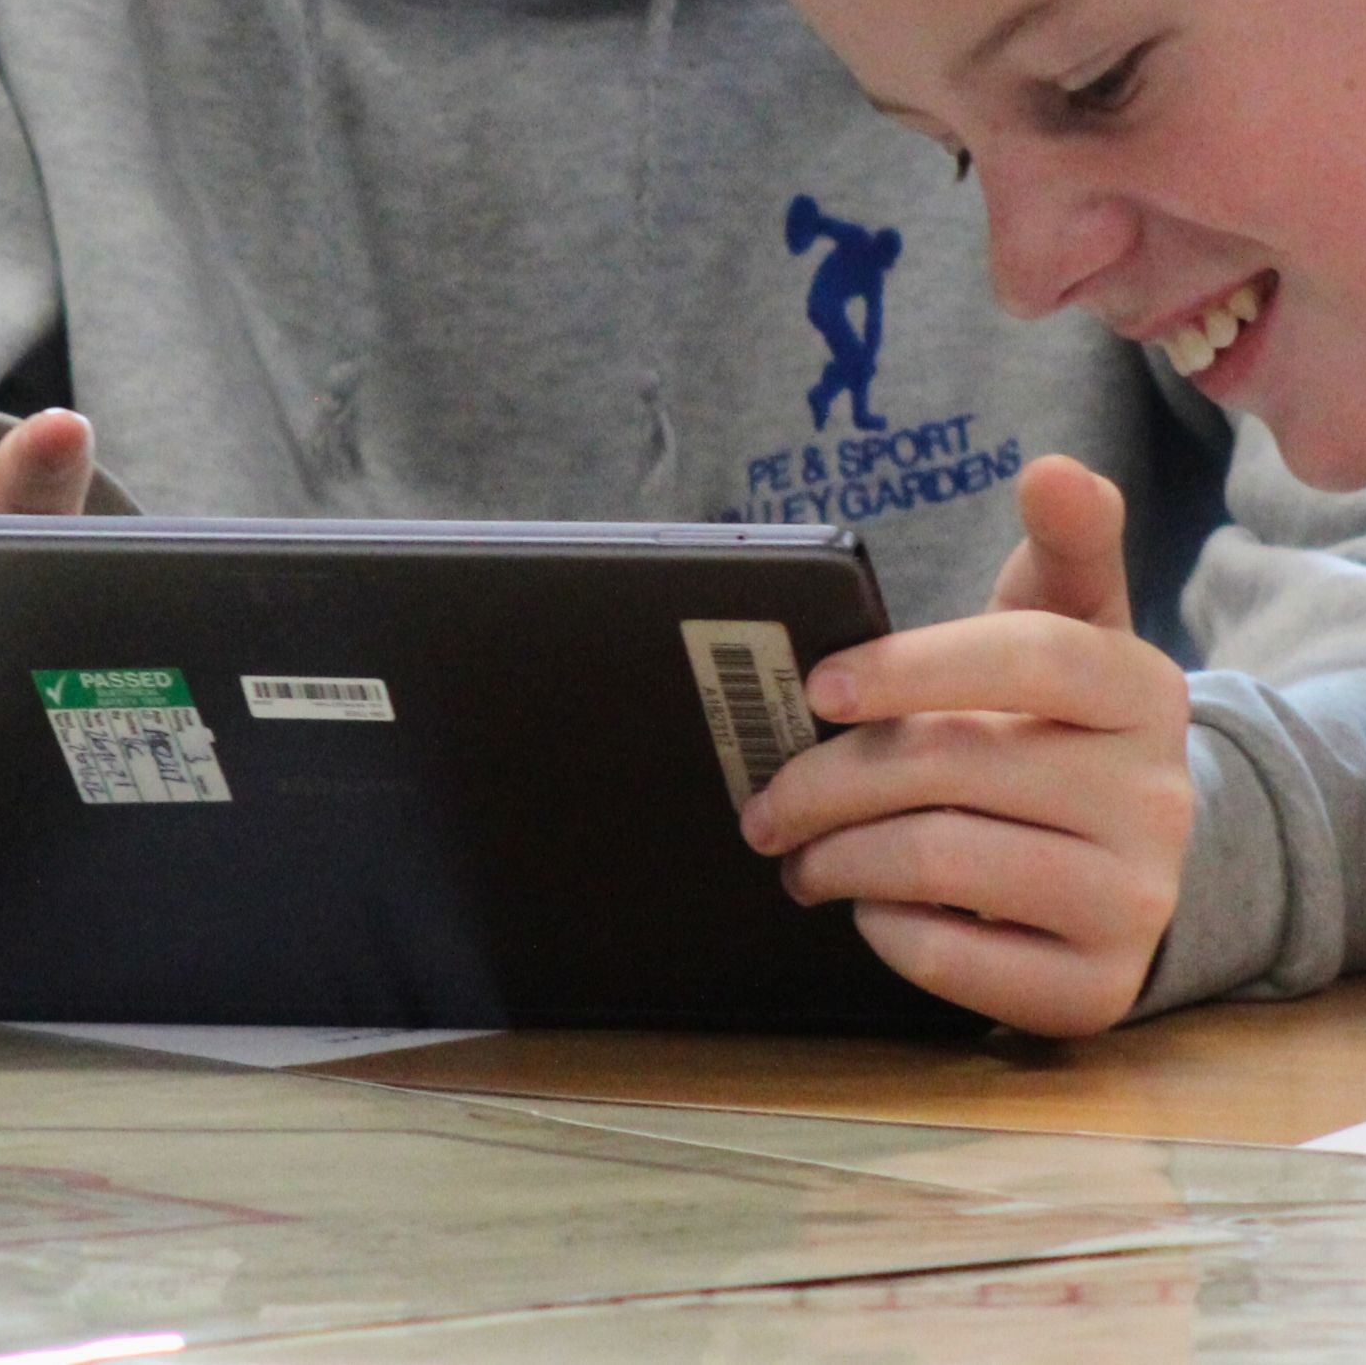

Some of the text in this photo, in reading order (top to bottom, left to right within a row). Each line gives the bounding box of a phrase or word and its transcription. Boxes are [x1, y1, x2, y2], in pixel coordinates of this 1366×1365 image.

[748, 414, 975, 494] PE & SPORT
[839, 438, 1022, 521] GARDENS
[80, 671, 174, 688] PASSED
